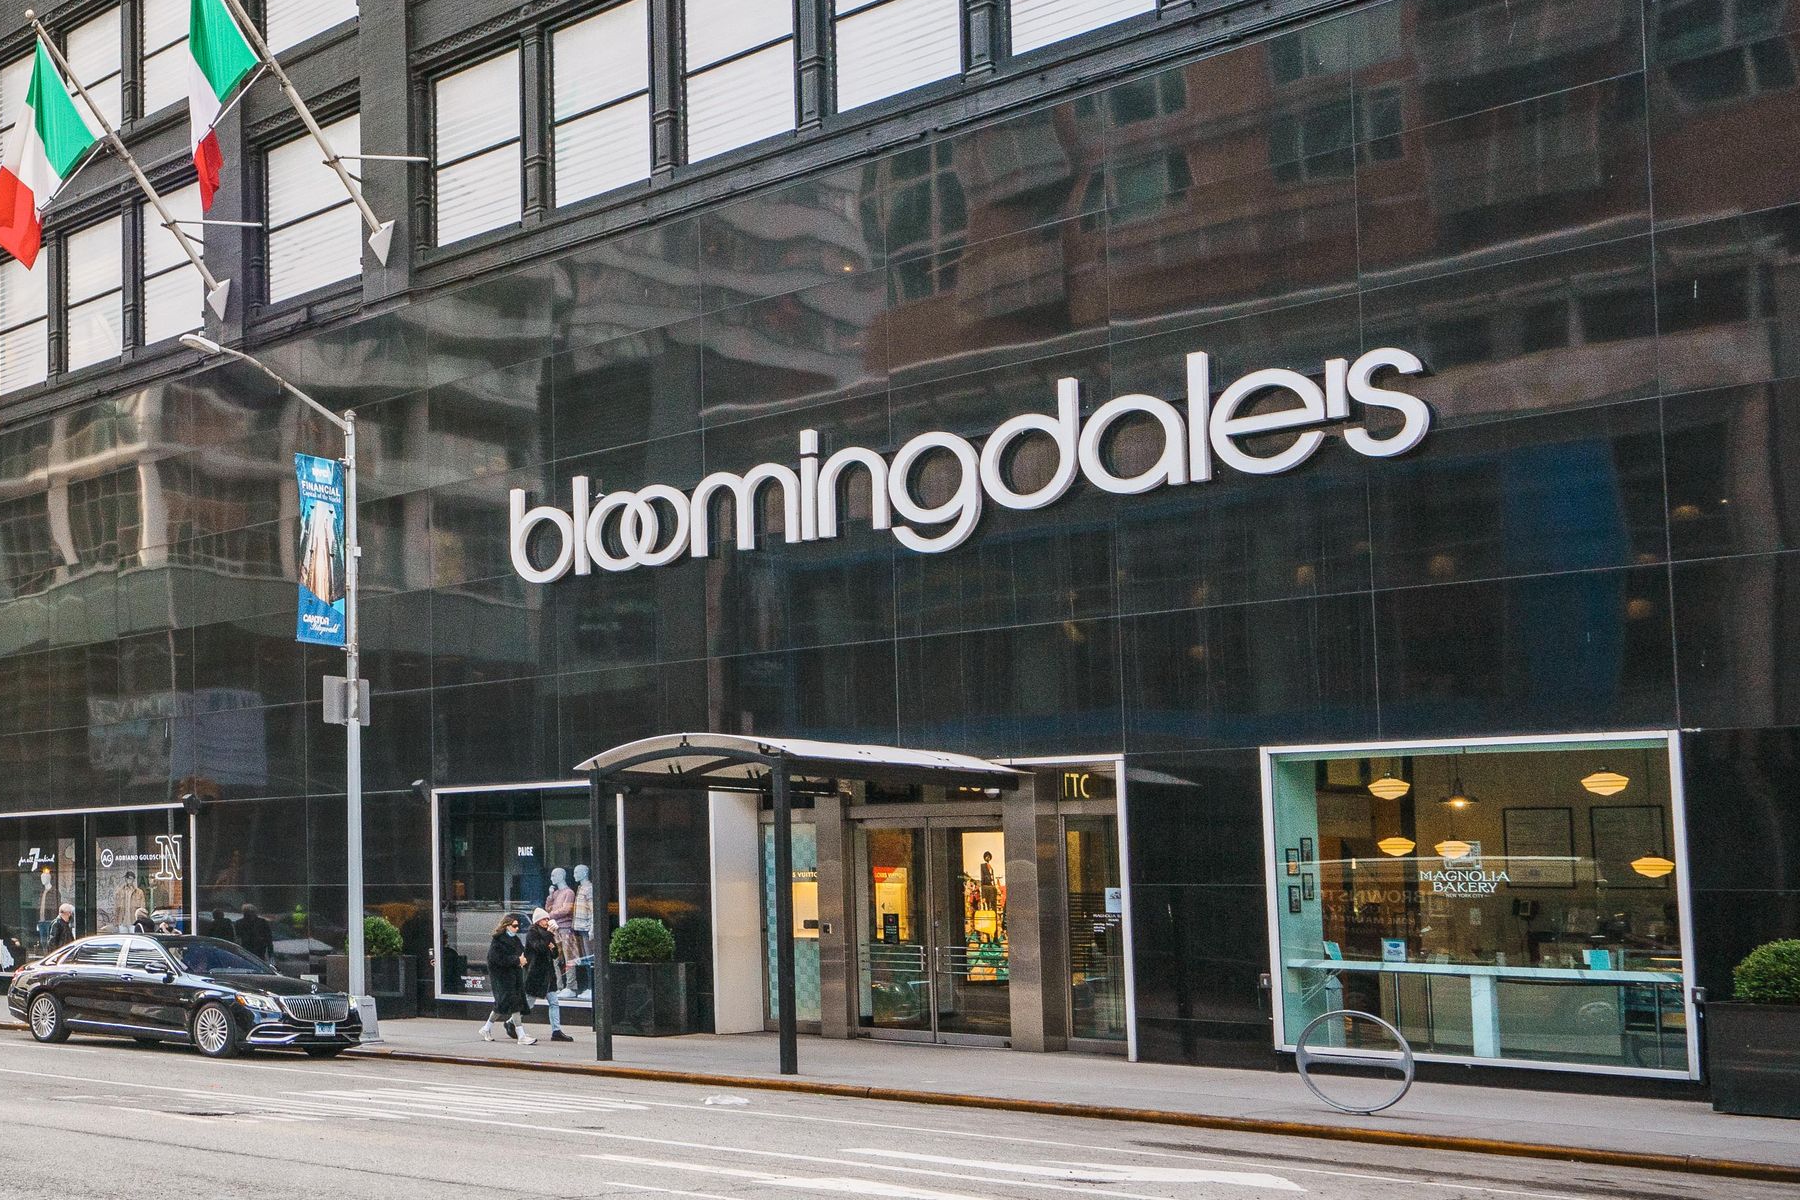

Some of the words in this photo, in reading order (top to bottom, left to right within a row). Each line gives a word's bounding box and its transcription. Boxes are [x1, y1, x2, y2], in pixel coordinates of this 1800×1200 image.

[510, 347, 1431, 585] bloomingdale's
[301, 480, 341, 498] FINANCIAL
[302, 613, 329, 625] CANTOR
[1419, 870, 1510, 882] MAGNOLIA
[1433, 881, 1498, 893] BAKERY
